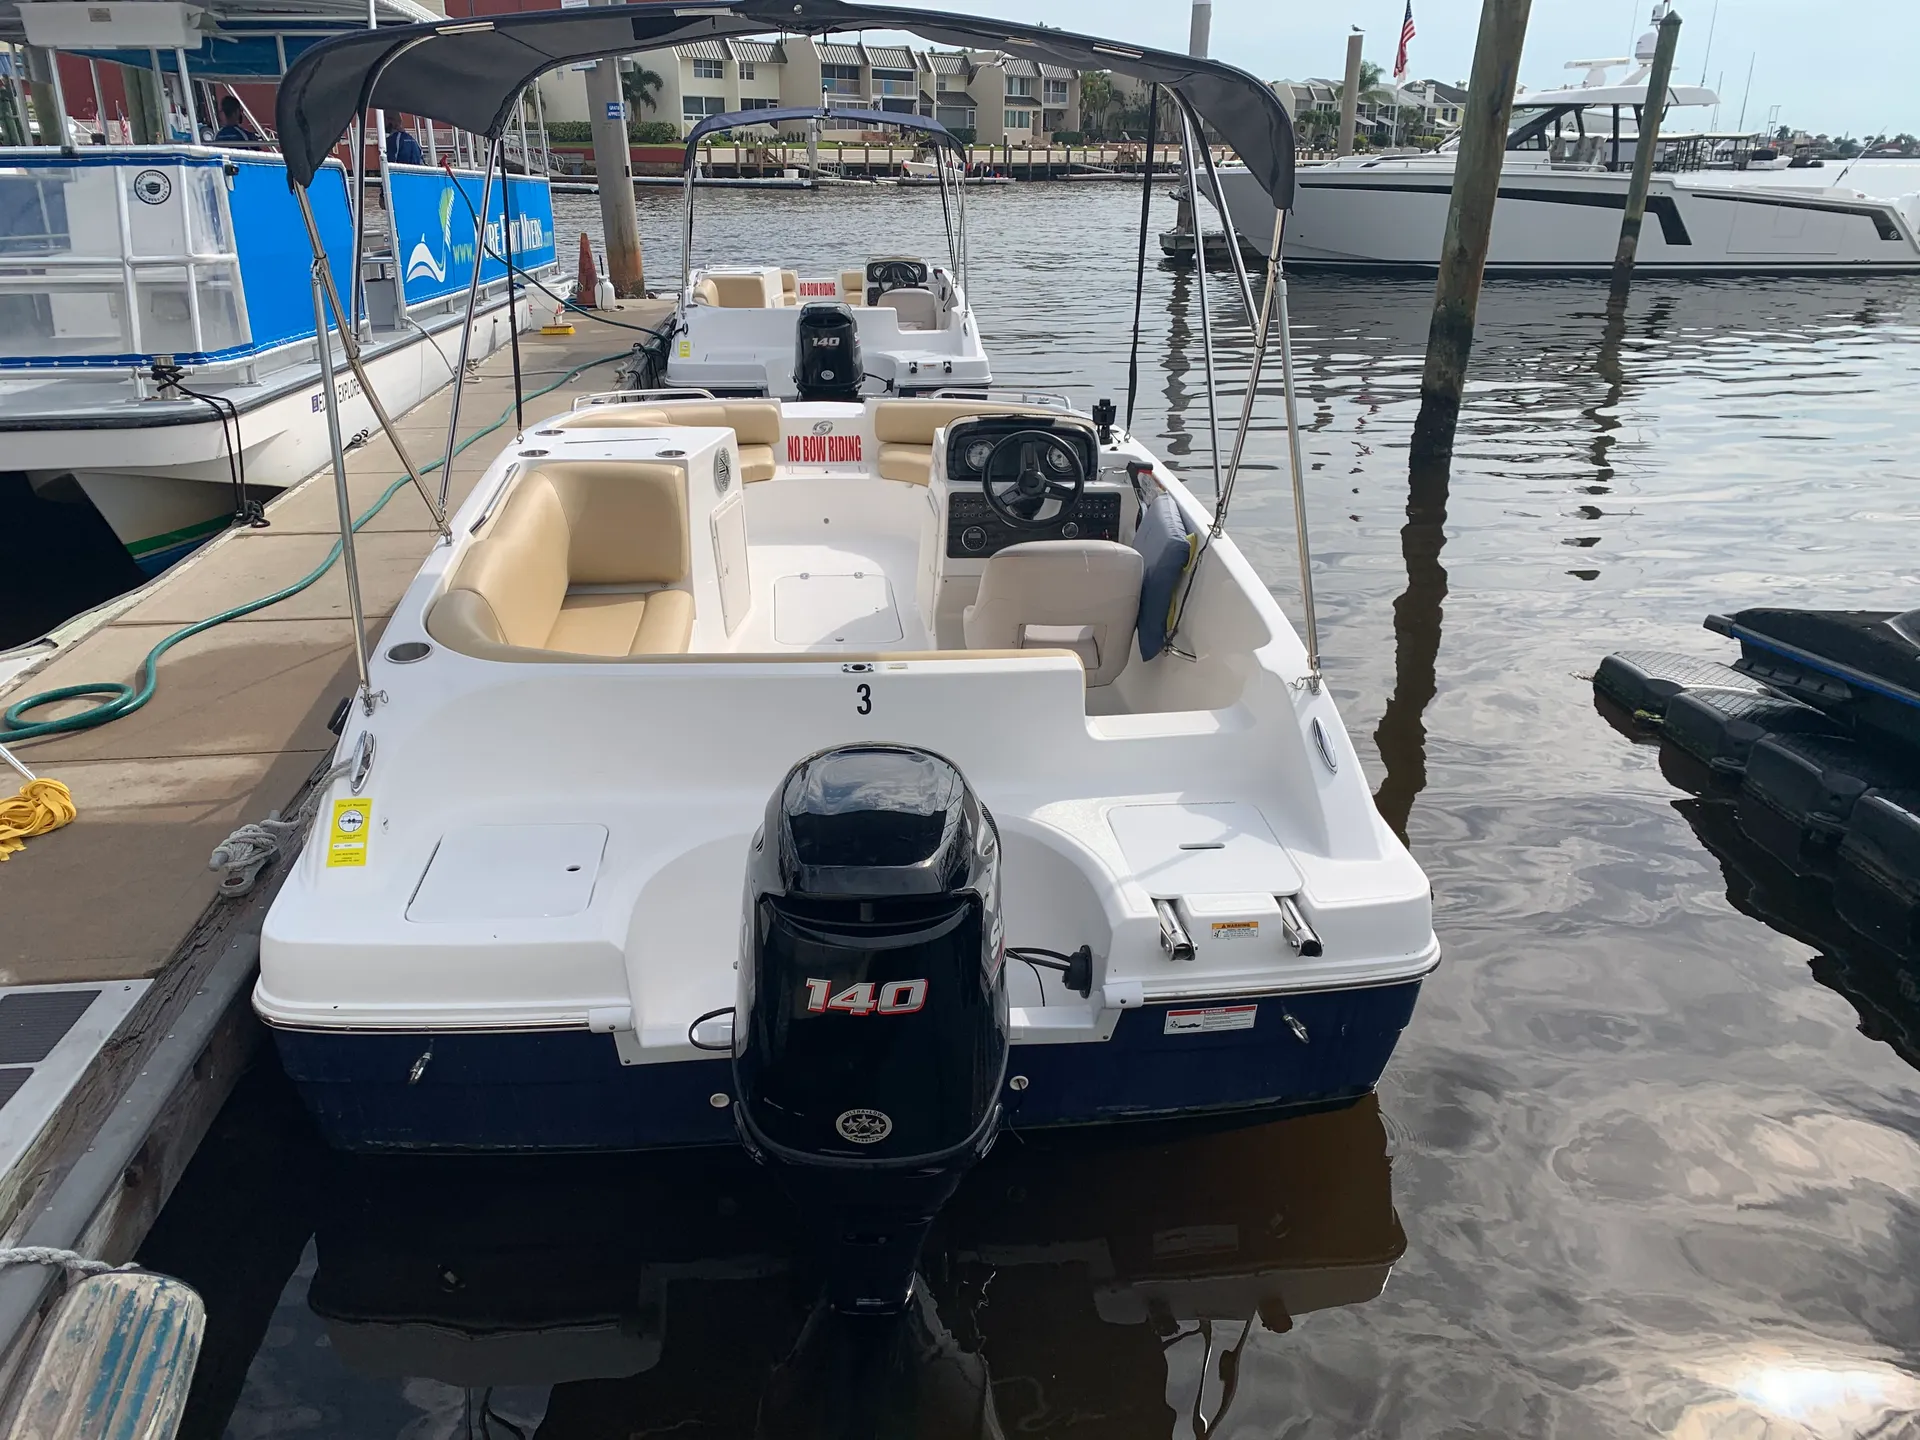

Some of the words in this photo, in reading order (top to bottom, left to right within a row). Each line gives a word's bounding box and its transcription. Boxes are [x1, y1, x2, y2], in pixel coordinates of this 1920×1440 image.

[500, 211, 521, 254] FRT
[799, 282, 807, 296] NO
[807, 282, 819, 296] BOW
[819, 282, 836, 296] RIDING
[812, 336, 840, 347] 140
[787, 435, 801, 462] NO
[803, 435, 826, 462] BOW
[828, 434, 862, 462] RIDING
[856, 683, 872, 715] 3
[805, 977, 928, 1016] 140
